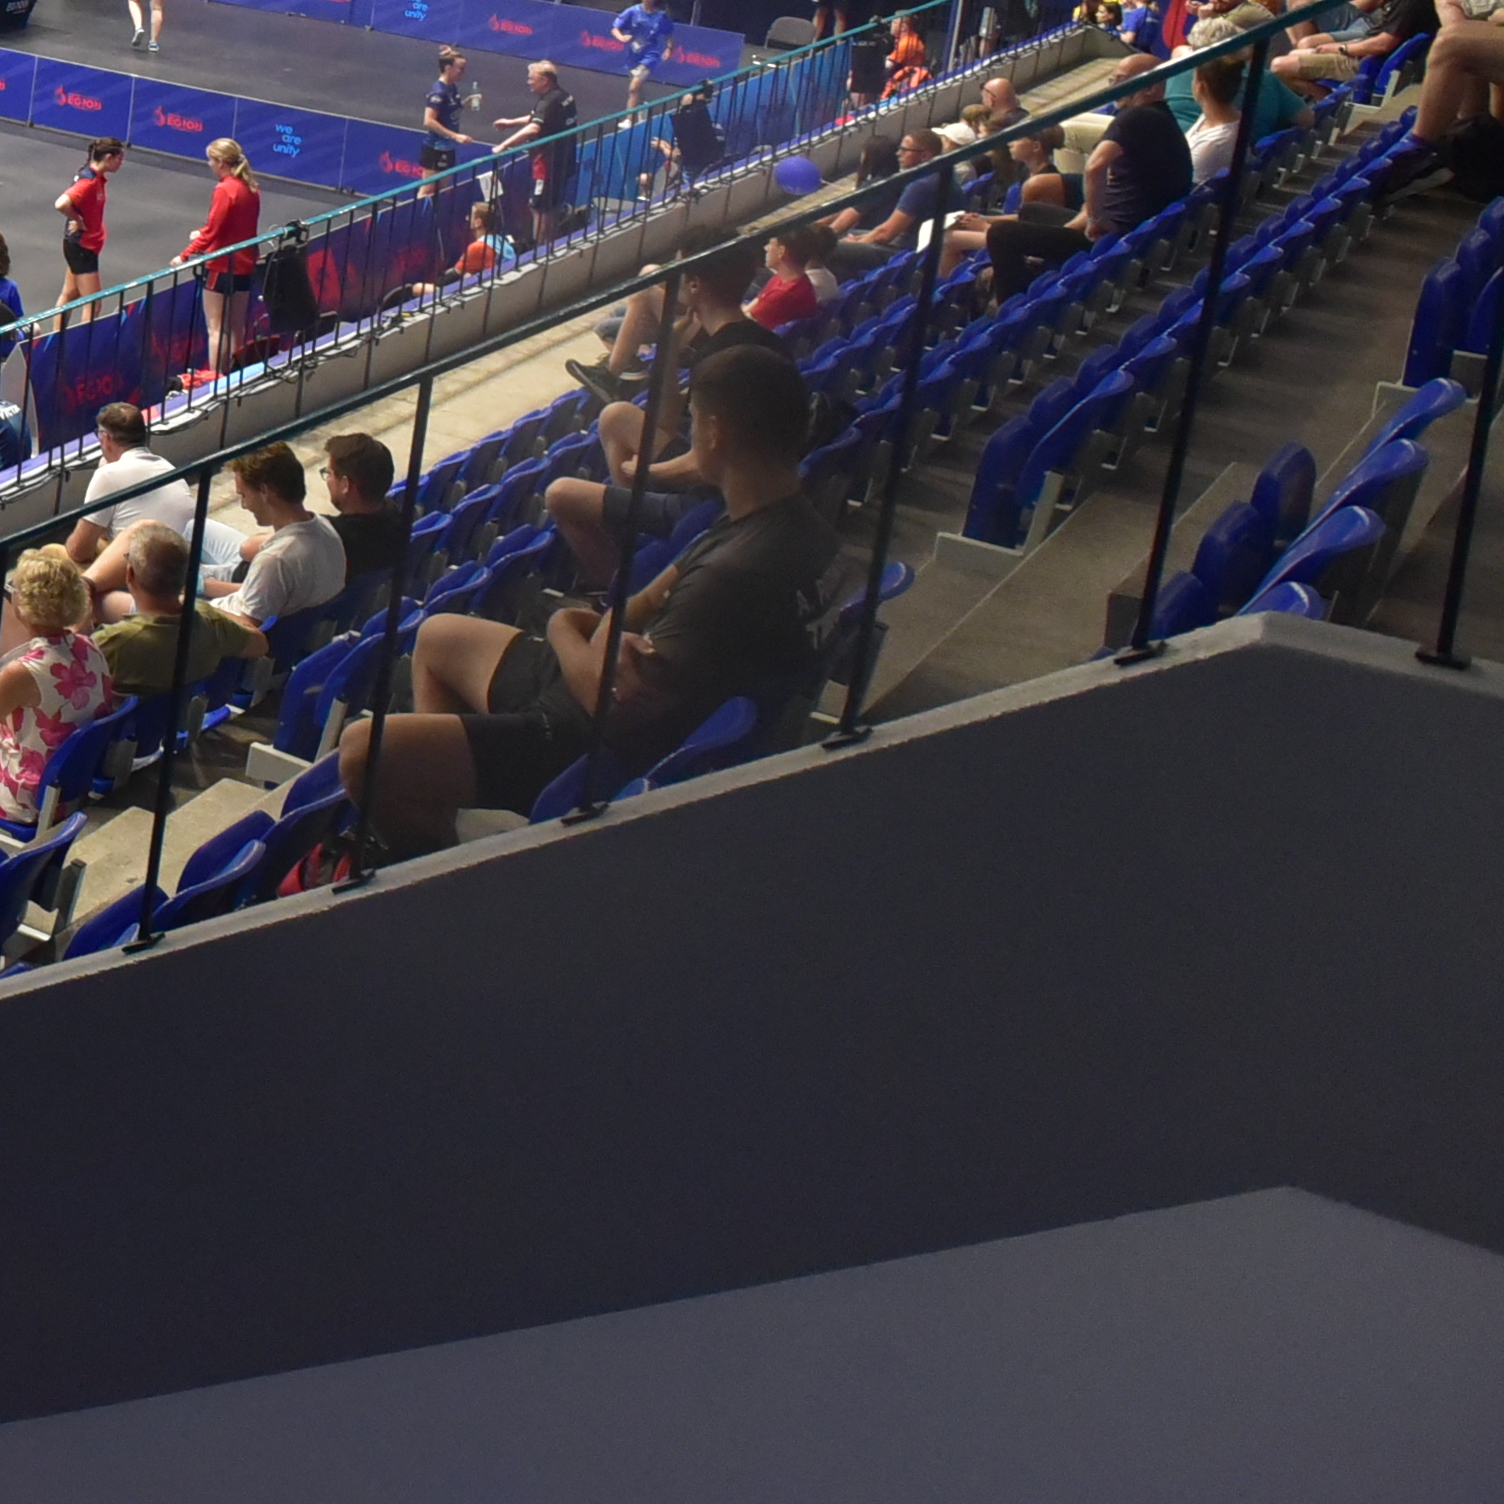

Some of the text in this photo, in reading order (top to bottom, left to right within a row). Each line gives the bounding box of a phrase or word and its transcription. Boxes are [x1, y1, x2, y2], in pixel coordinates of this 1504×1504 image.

[412, 2, 428, 11] are
[405, 10, 426, 22] unity
[275, 124, 293, 134] we
[282, 133, 302, 145] are
[273, 143, 300, 158] unity
